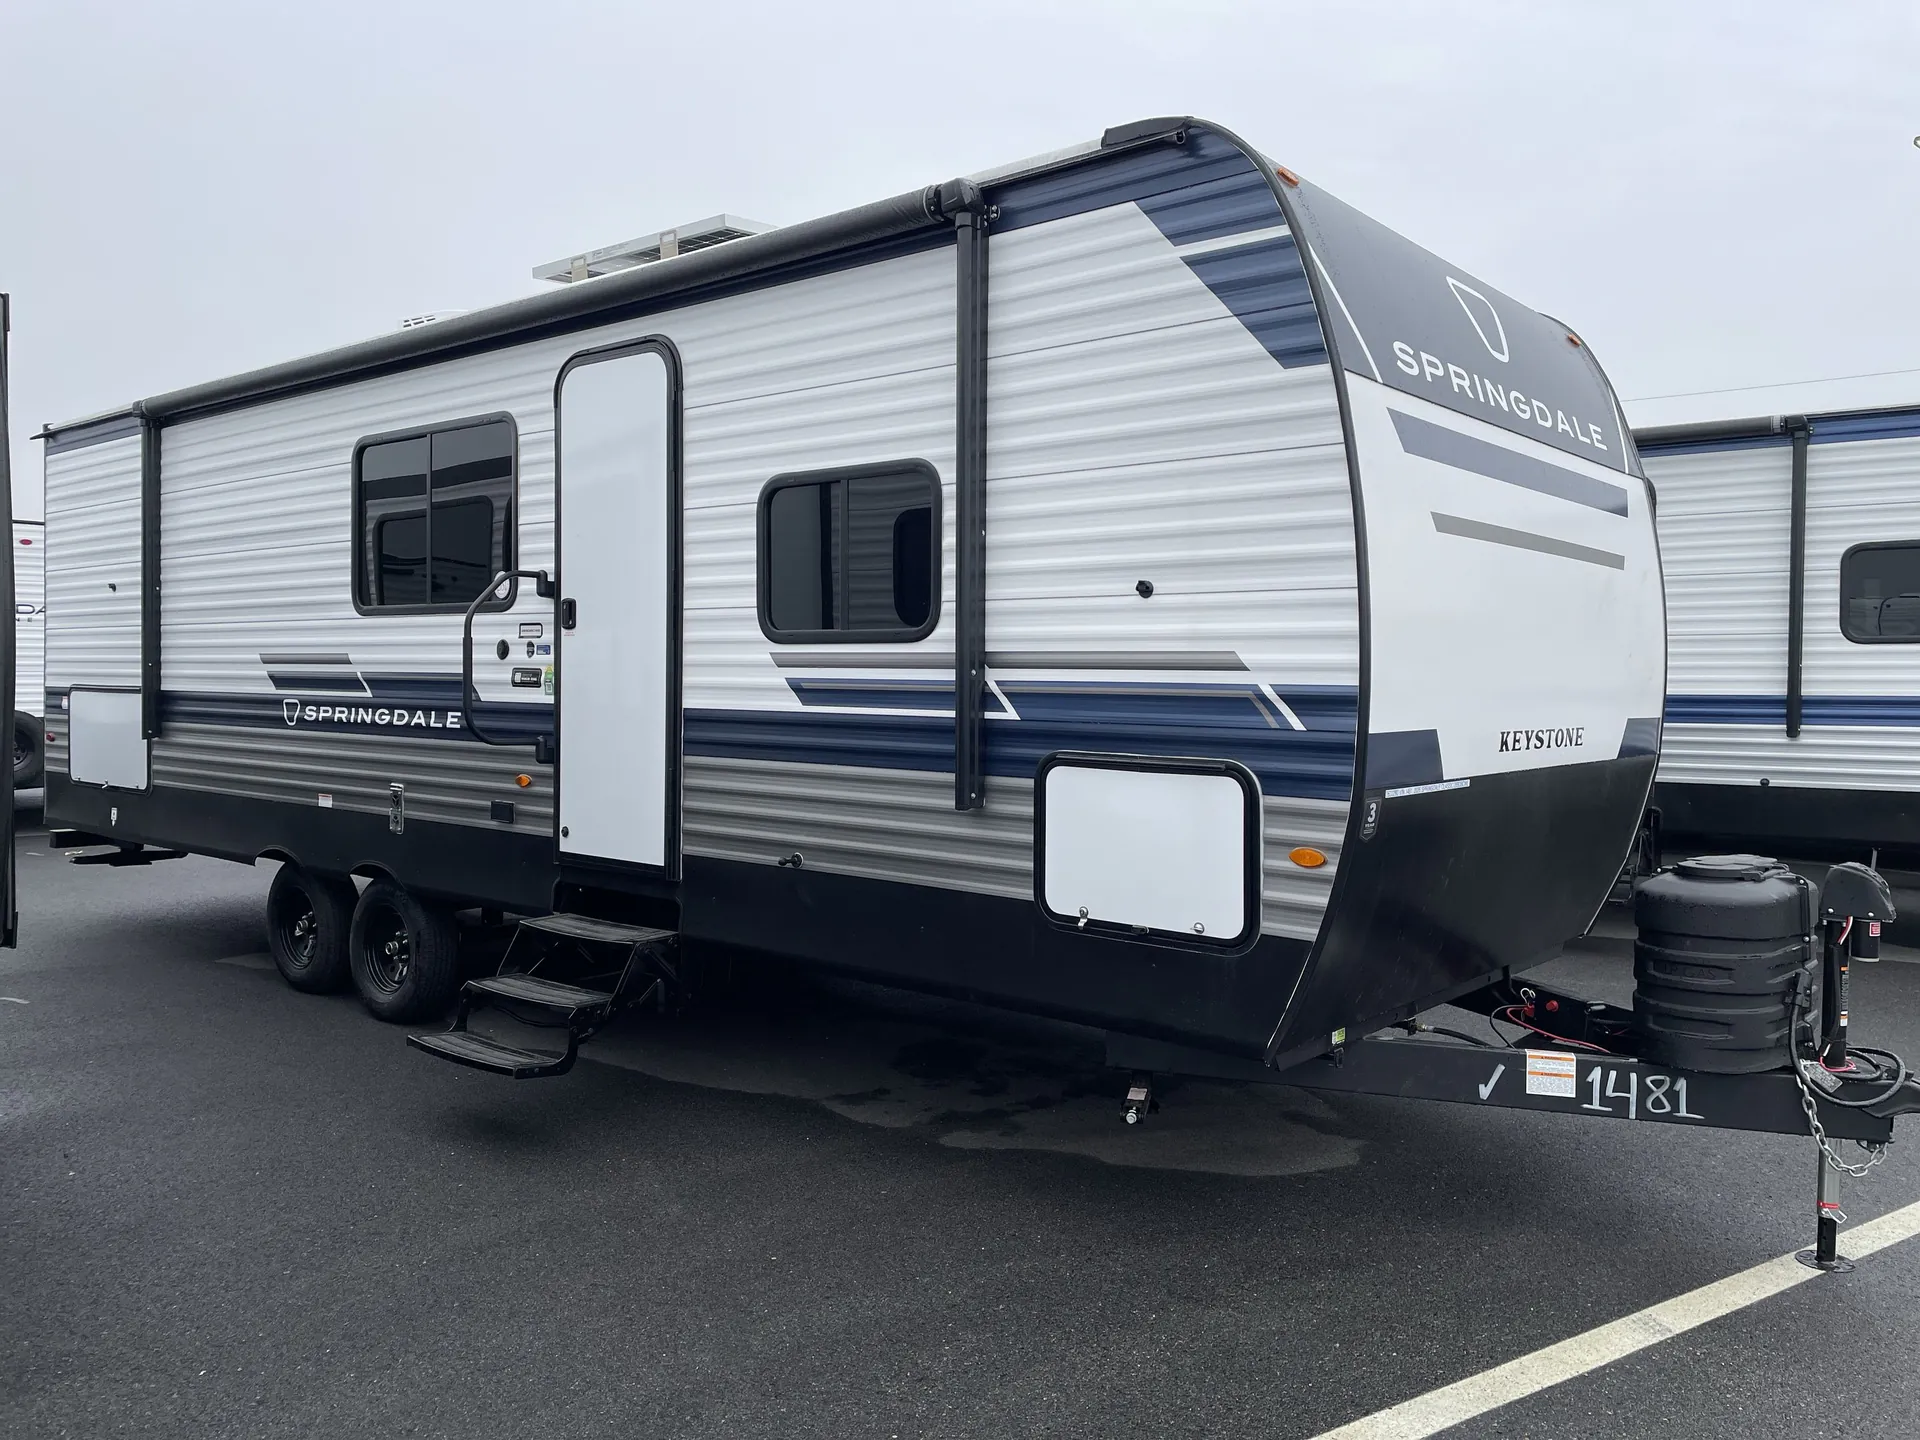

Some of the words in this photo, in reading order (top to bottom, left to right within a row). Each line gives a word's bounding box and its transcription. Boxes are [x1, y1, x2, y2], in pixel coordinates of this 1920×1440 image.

[1393, 341, 1607, 450] SPRINGDALE
[304, 706, 462, 728] SPRINGDALE
[1499, 727, 1584, 752] KEYSTONE
[1367, 802, 1377, 822] 3
[1580, 1066, 1705, 1119] 1481
